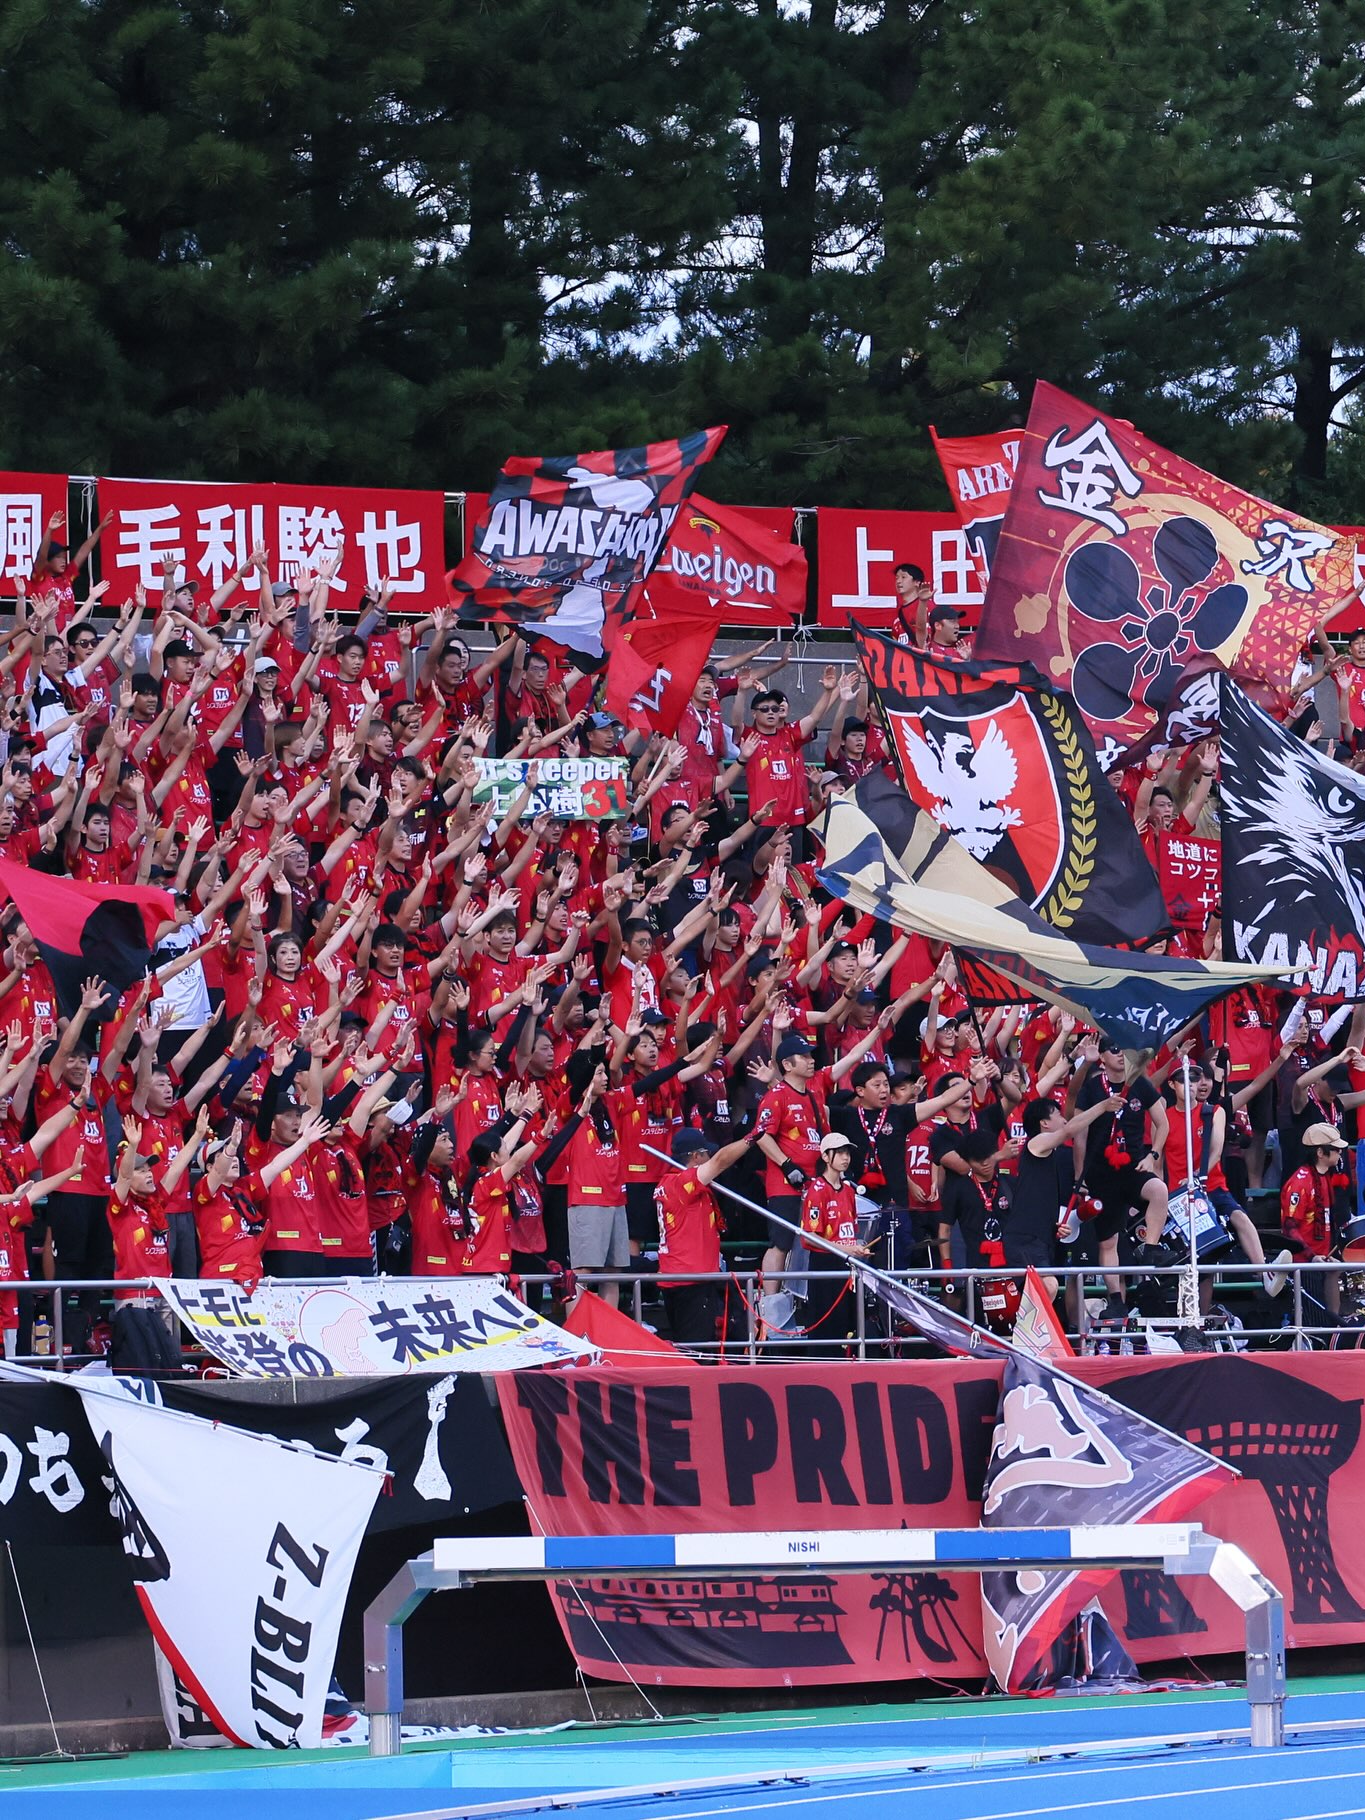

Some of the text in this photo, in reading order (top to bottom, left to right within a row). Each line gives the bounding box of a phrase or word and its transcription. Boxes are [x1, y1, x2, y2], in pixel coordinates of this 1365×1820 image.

[115, 502, 425, 594] 毛利駿也
[656, 543, 777, 597] weigen
[831, 526, 985, 609] 上田
[581, 776, 628, 817] 31
[1167, 839, 1218, 862] 地道に
[907, 1145, 931, 1168] 12
[368, 1293, 542, 1364] 未来へ!
[518, 1369, 701, 1507] THE
[788, 1541, 820, 1553] NISHI
